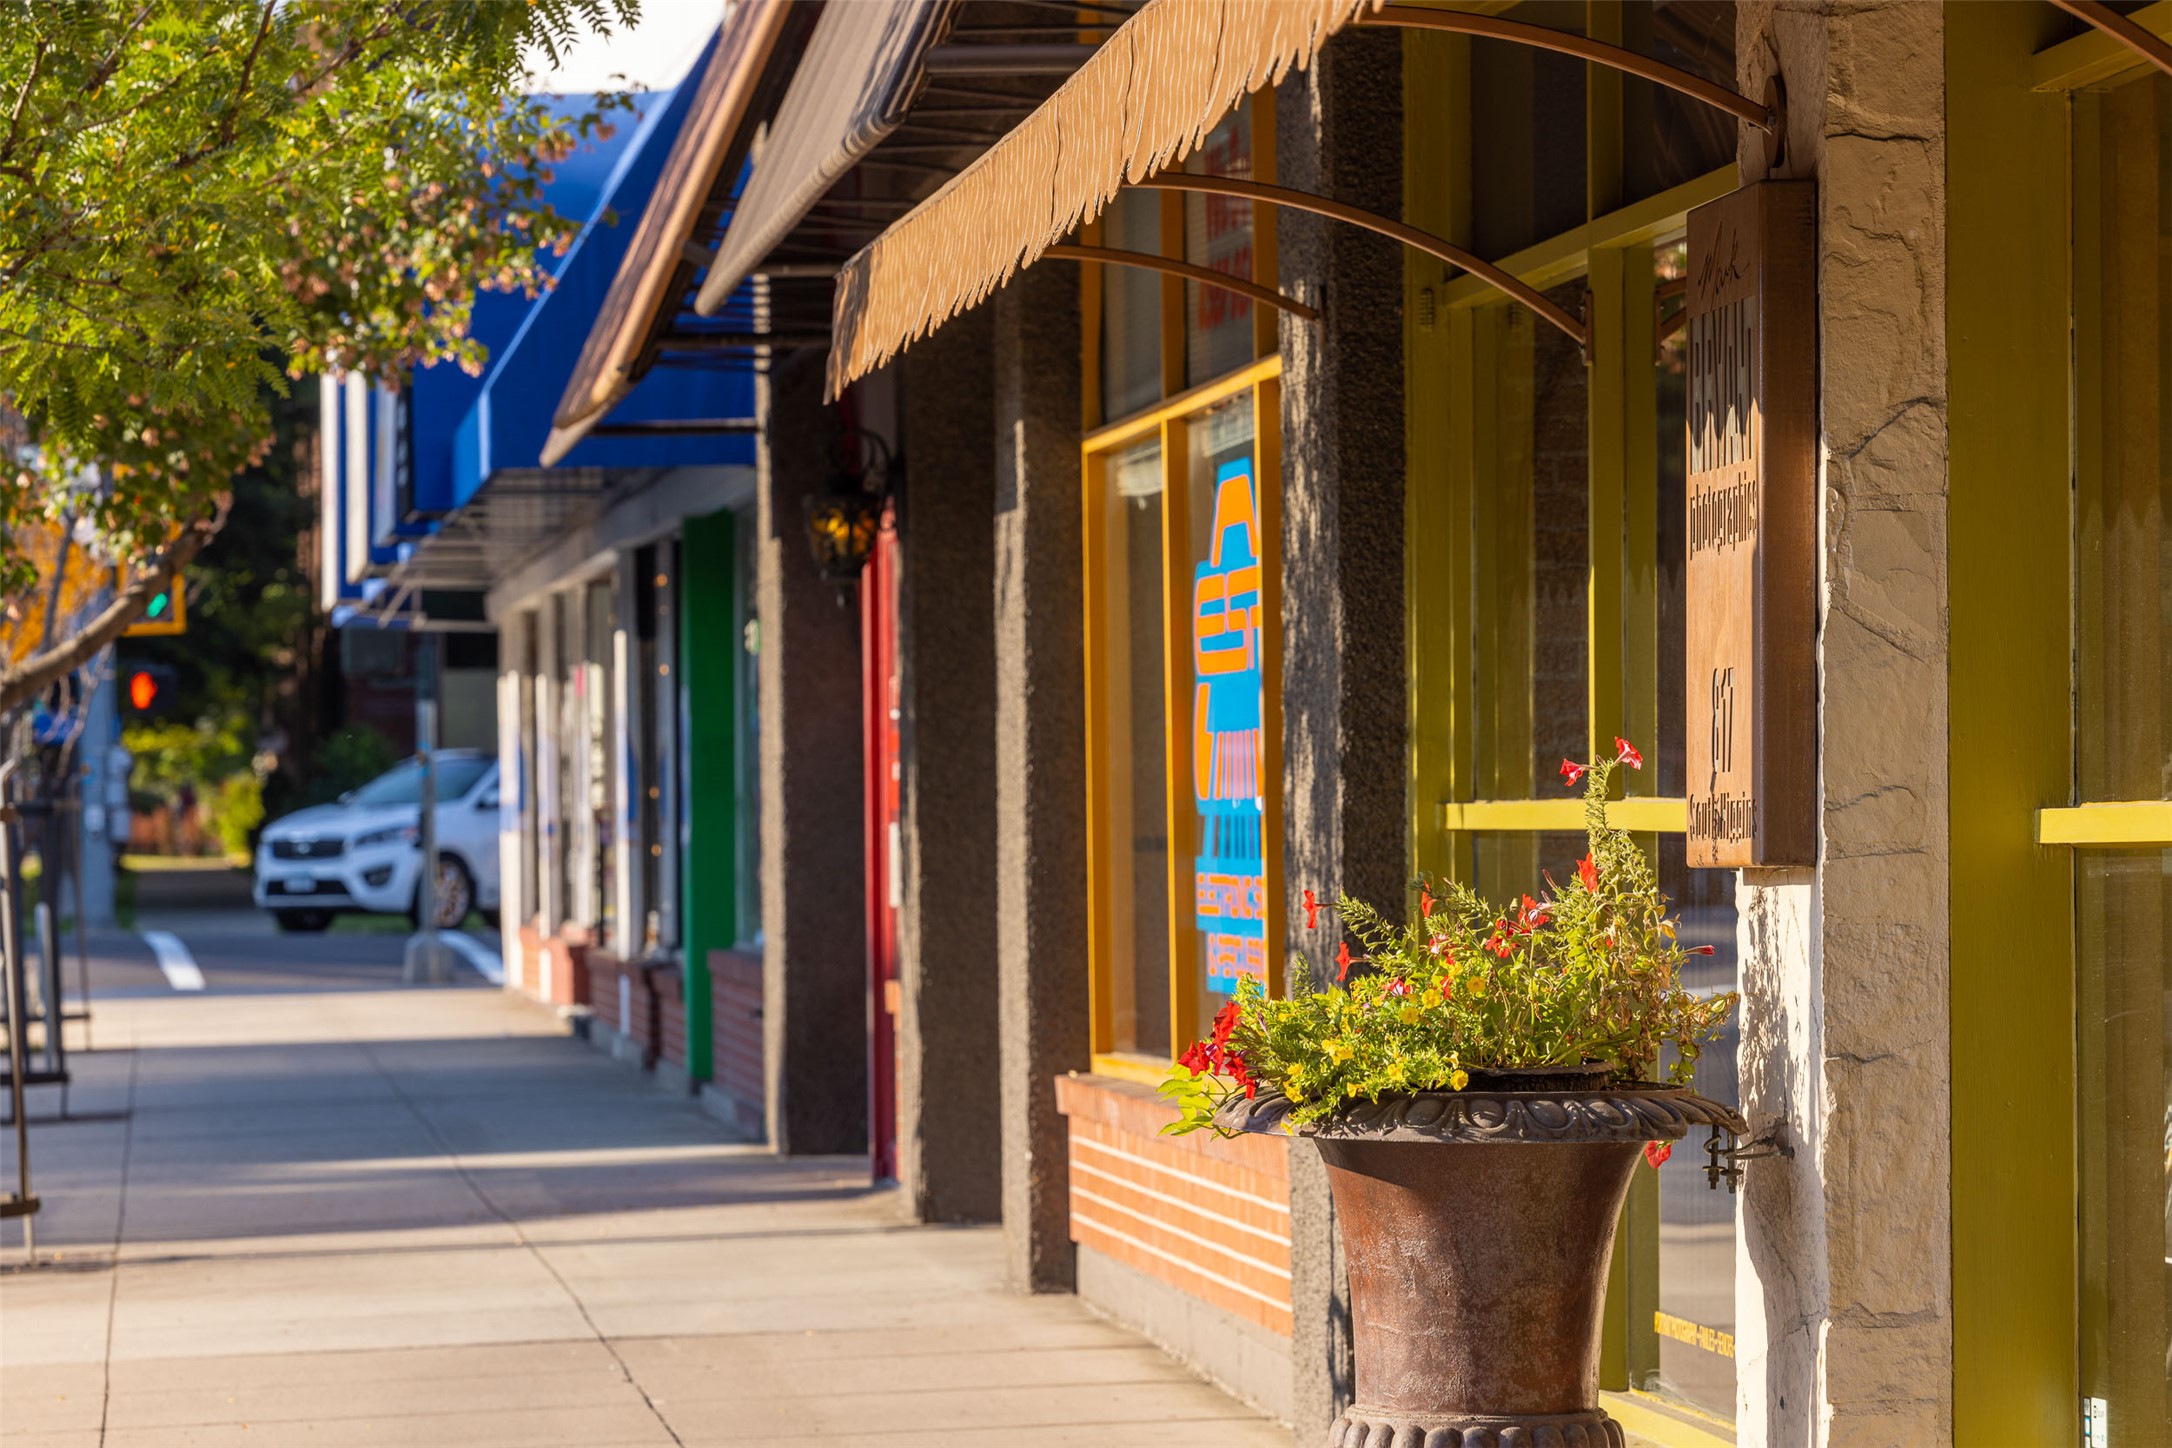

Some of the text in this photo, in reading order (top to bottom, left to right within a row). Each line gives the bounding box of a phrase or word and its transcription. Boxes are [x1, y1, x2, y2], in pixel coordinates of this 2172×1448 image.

[1697, 220, 1750, 310] Mark
[1690, 791, 1758, 845] South Higgins
